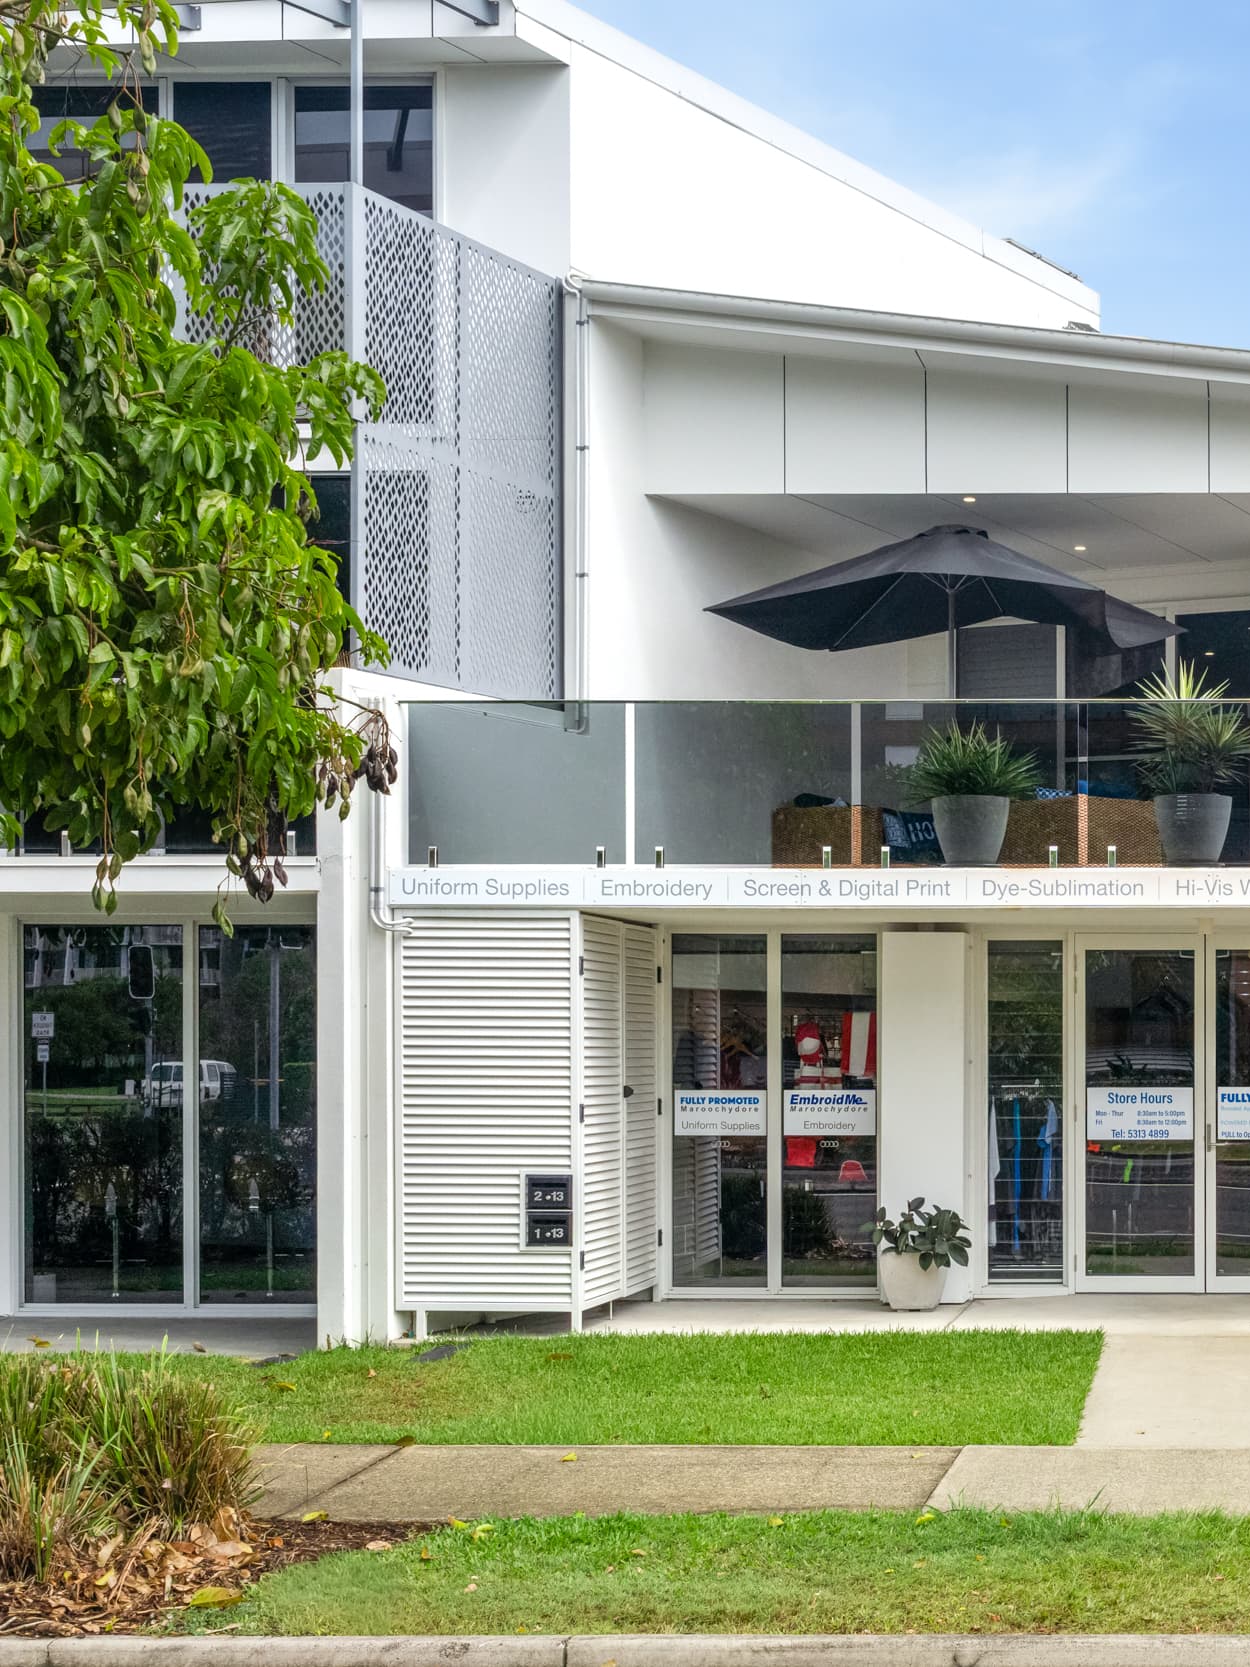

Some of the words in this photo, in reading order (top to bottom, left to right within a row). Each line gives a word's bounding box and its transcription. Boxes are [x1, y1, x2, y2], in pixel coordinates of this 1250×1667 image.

[402, 878, 482, 895] Uniform
[485, 878, 569, 900] Supplies
[602, 880, 712, 900] Embroidery
[744, 878, 811, 896] Screen
[819, 880, 832, 896] &
[840, 880, 898, 900] Digital
[907, 880, 950, 896] Print
[983, 878, 1143, 900] Dye-Sublimation
[1176, 878, 1233, 896] Hi-Vis
[790, 1094, 868, 1105] EmbroidMe
[1108, 1092, 1137, 1104] Store
[1141, 1092, 1172, 1103] Hours
[681, 1105, 758, 1114] Maroochydore
[790, 1105, 868, 1114] Maroochydore
[1165, 1110, 1186, 1118] 5:00pm
[682, 1120, 718, 1129] Uniform
[721, 1121, 760, 1131] Supplies
[804, 1120, 856, 1130] Embroidery
[1112, 1129, 1125, 1138] Tel:
[1128, 1130, 1146, 1138] 5313
[1148, 1129, 1169, 1138] 4899
[534, 1192, 542, 1201] 2
[551, 1192, 563, 1201] 13
[534, 1228, 540, 1238] 1
[551, 1228, 563, 1238] 13
